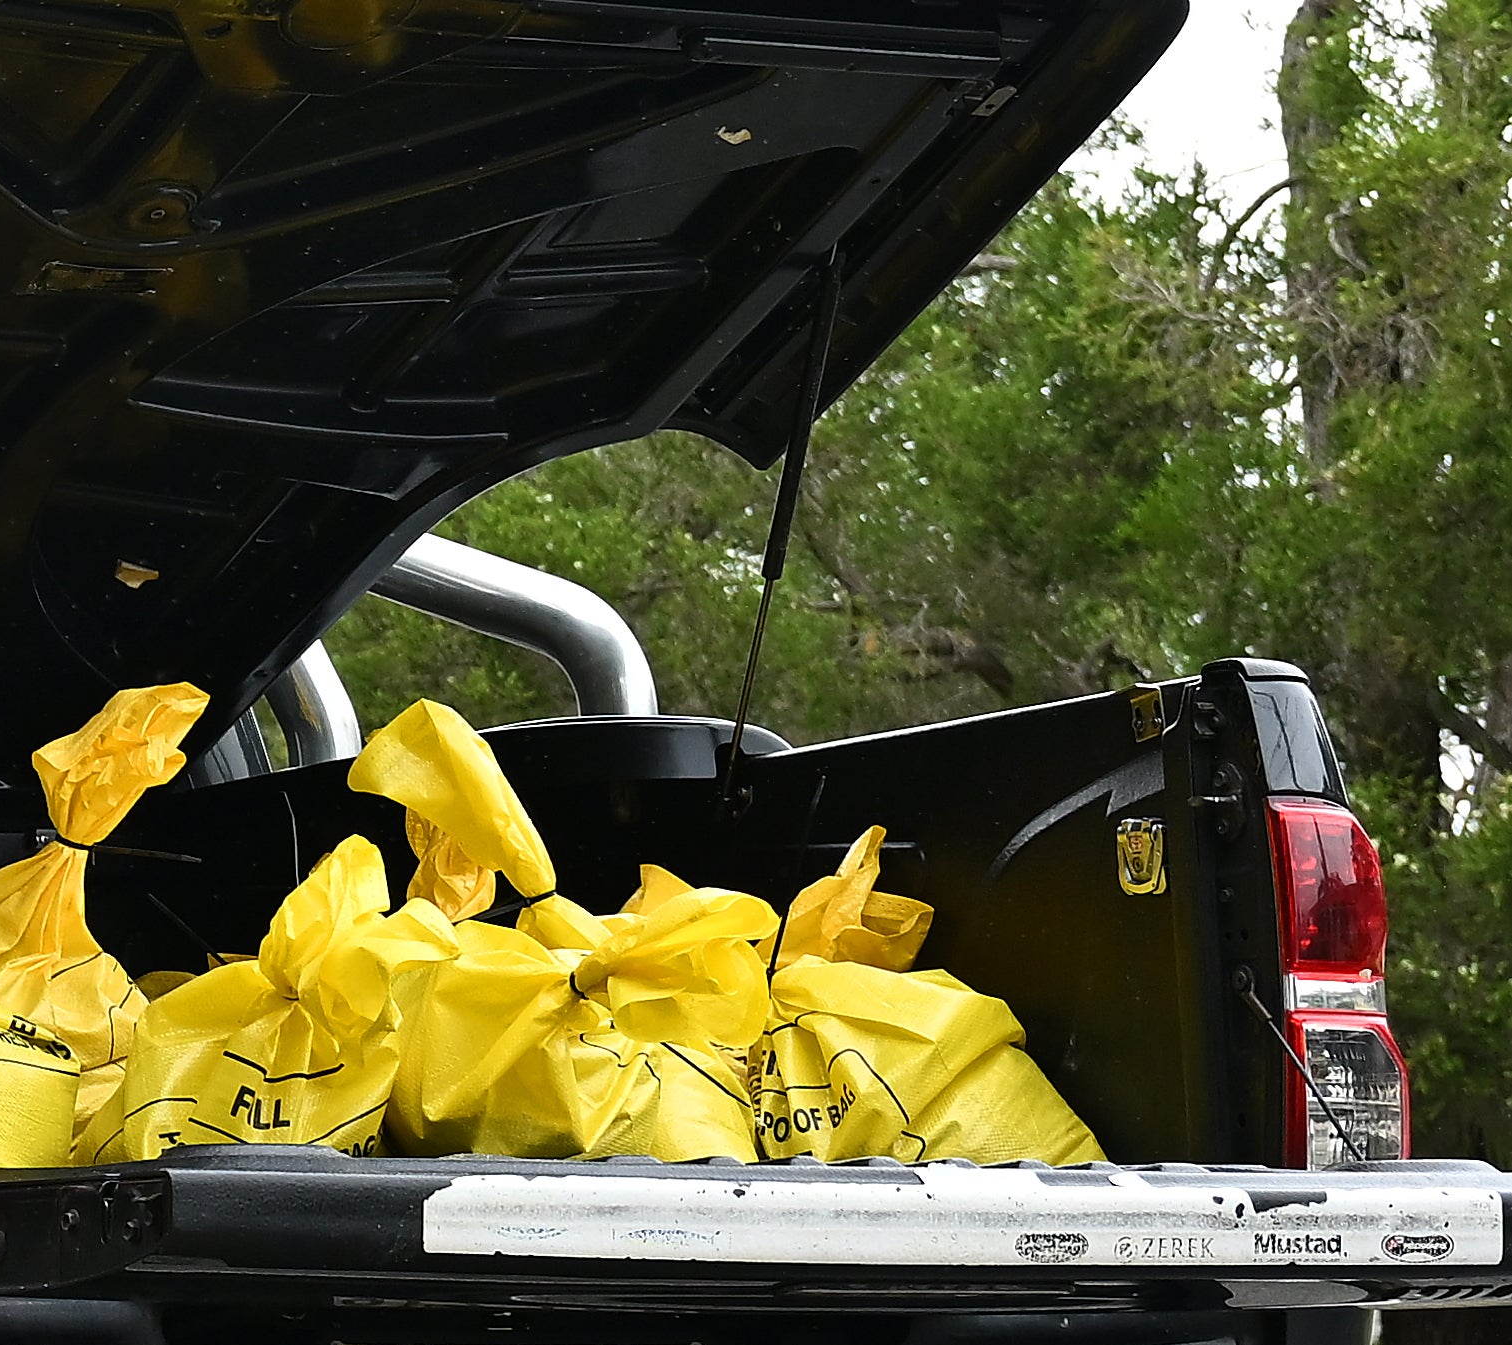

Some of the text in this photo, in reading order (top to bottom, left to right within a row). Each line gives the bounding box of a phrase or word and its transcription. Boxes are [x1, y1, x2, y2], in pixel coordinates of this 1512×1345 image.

[230, 1085, 291, 1130] FILL
[793, 1107, 823, 1133] OF
[826, 1082, 856, 1129] BAG
[1141, 1237, 1215, 1259] ZEREK
